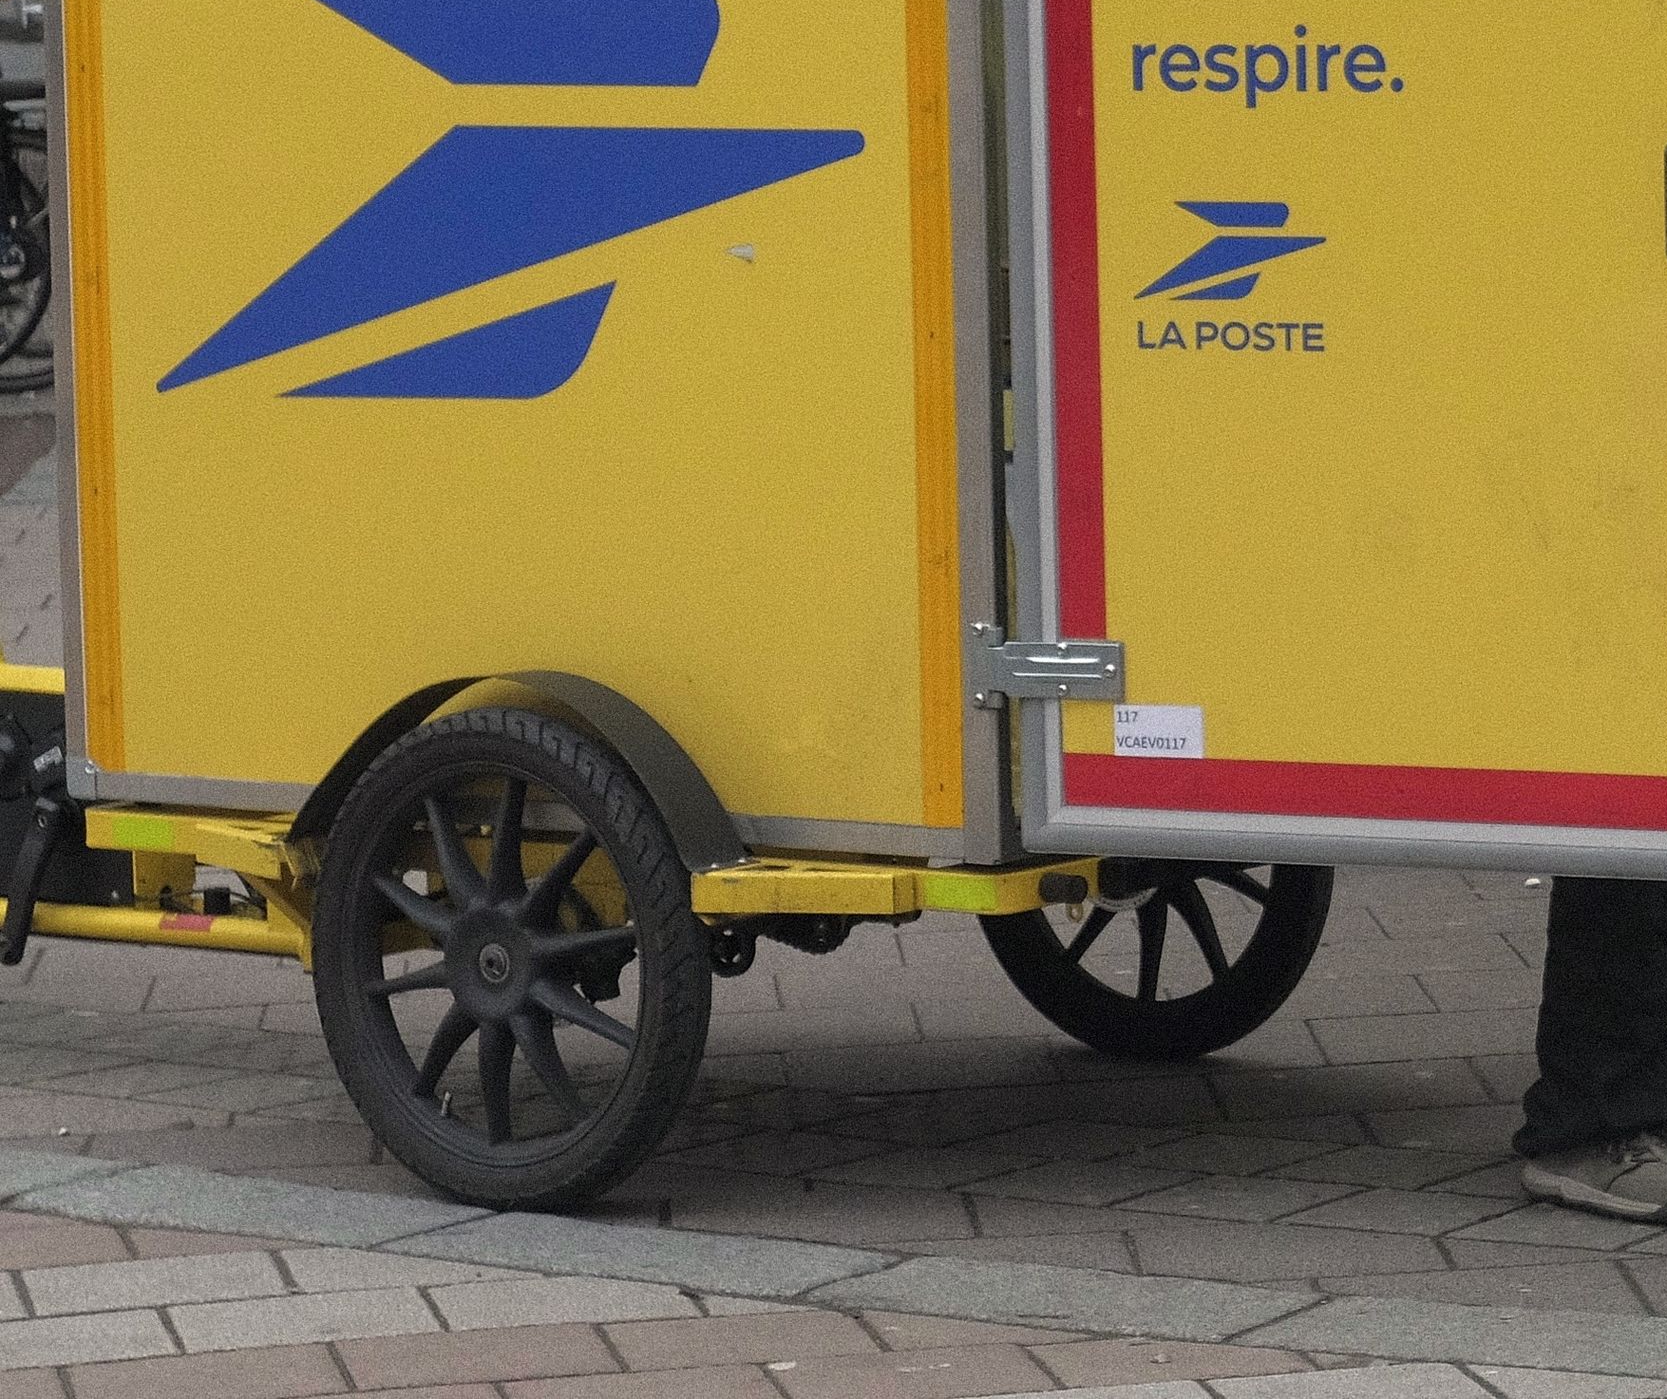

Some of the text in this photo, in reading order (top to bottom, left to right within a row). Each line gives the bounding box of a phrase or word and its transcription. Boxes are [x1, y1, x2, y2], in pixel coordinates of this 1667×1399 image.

[1131, 24, 1404, 108] respire.
[1135, 320, 1326, 353] LA POSTE
[1117, 711, 1138, 722] 117
